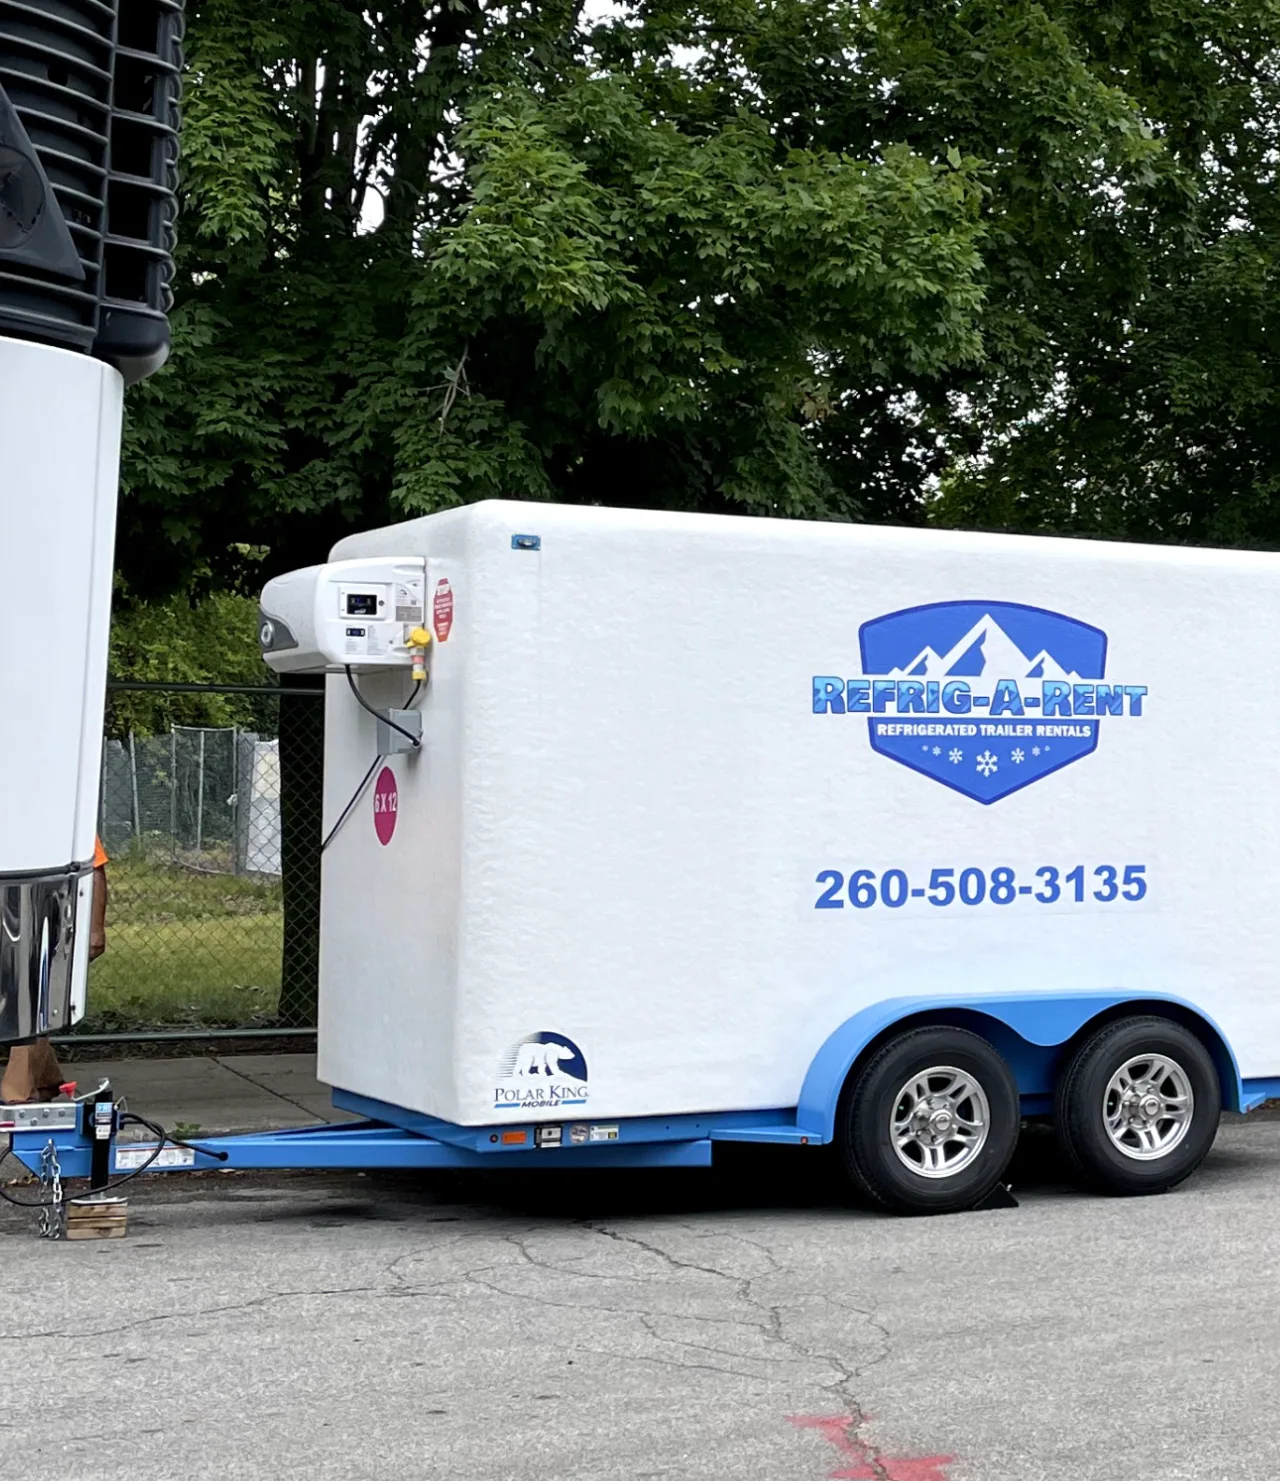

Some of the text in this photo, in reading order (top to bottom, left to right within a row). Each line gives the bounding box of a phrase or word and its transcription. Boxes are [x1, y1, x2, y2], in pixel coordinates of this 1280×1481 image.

[812, 676, 1148, 716] REFRIG-A-RENT
[877, 723, 1091, 738] REFRIGERATED TRAILER RENTALS
[375, 793, 380, 813] 6
[388, 791, 397, 812] 12
[814, 865, 1147, 909] 260-508-3135
[494, 1088, 545, 1102] POLAR
[521, 1100, 560, 1108] MOBILE
